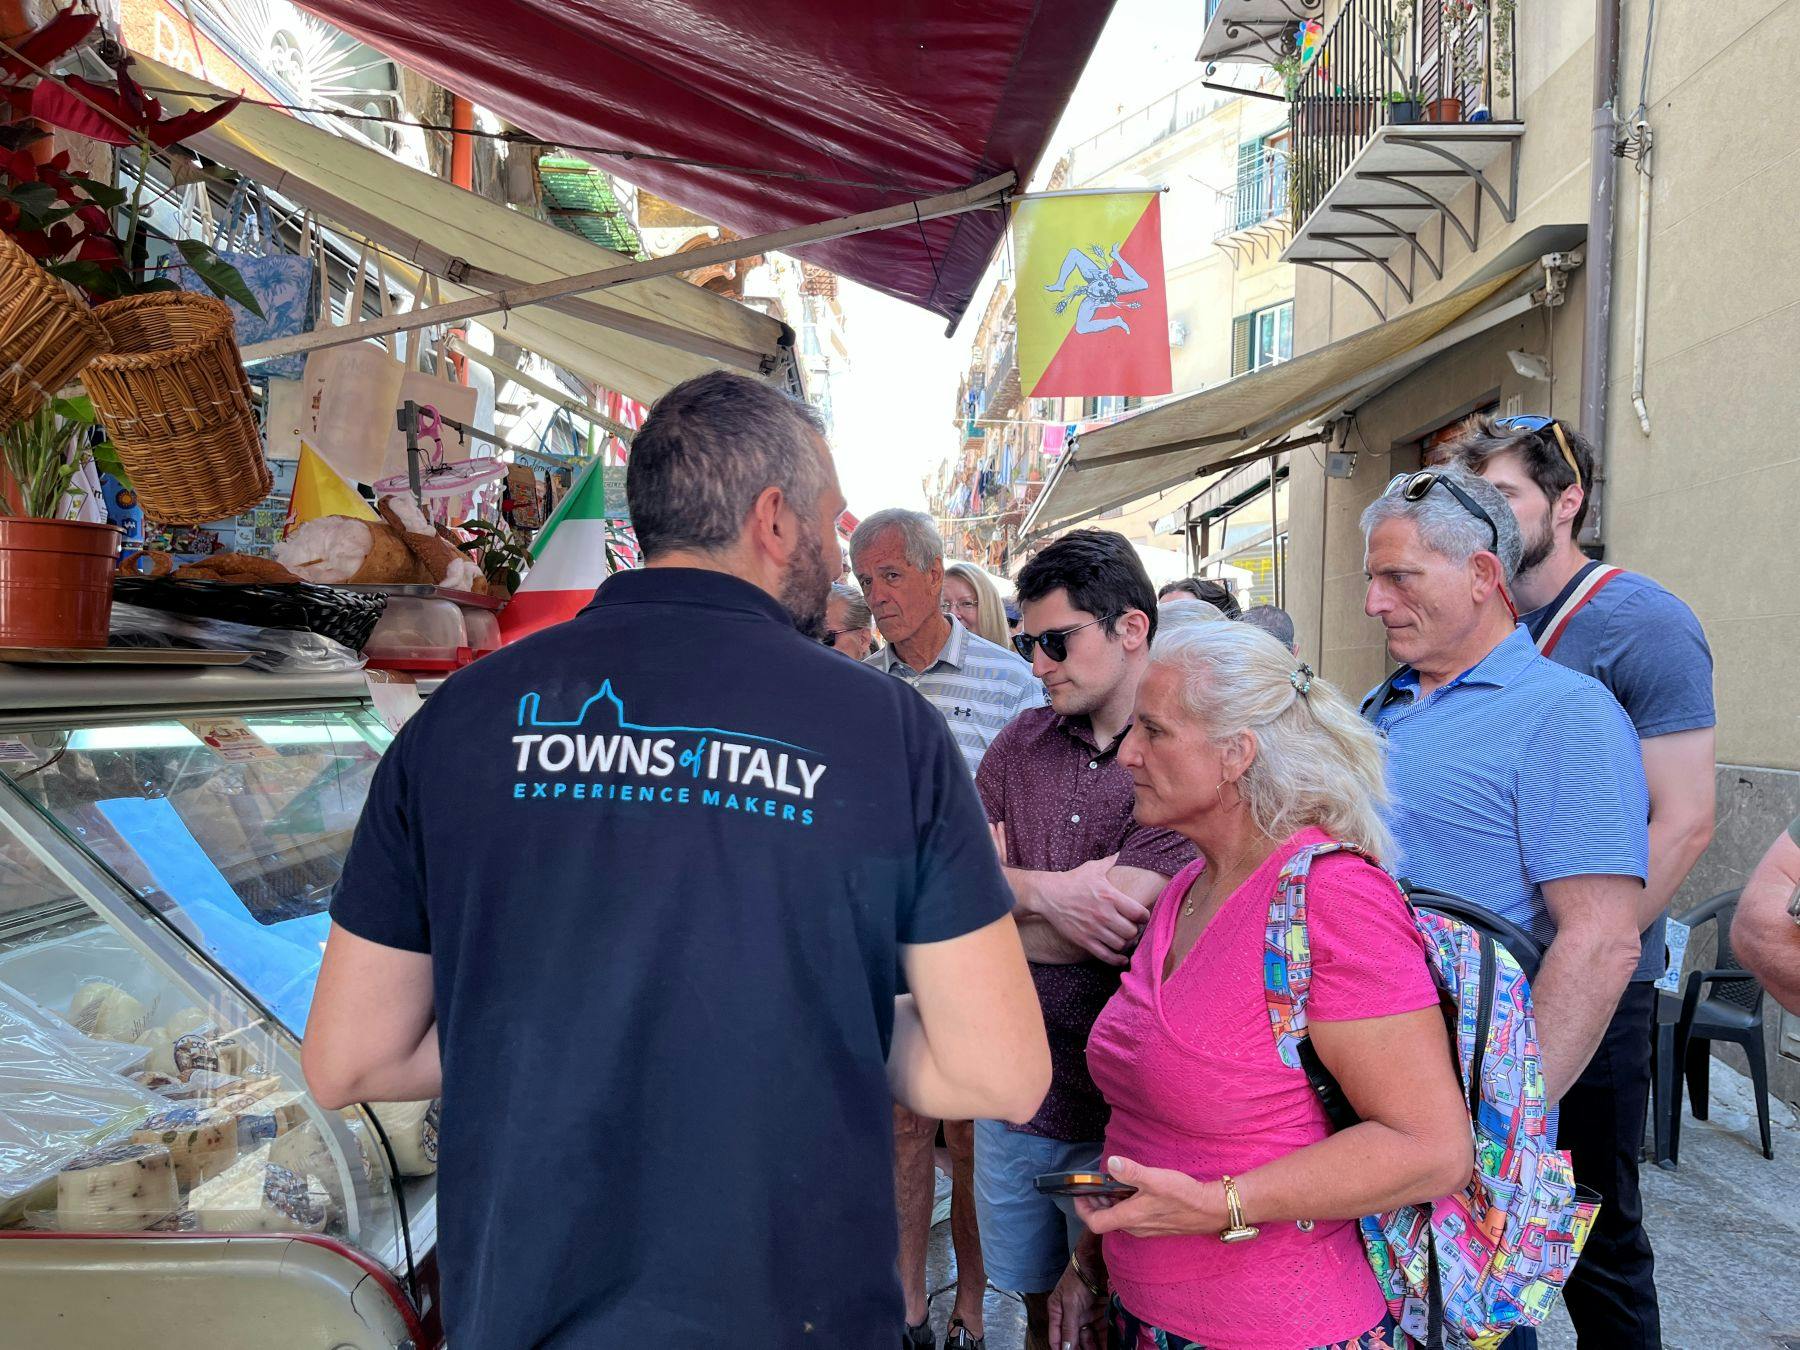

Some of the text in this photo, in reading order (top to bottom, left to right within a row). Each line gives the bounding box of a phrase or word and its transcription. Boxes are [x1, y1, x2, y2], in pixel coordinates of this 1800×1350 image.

[512, 734, 827, 800] TOWNS of ITALY
[514, 783, 814, 825] EXPERIENCE MAKERS
